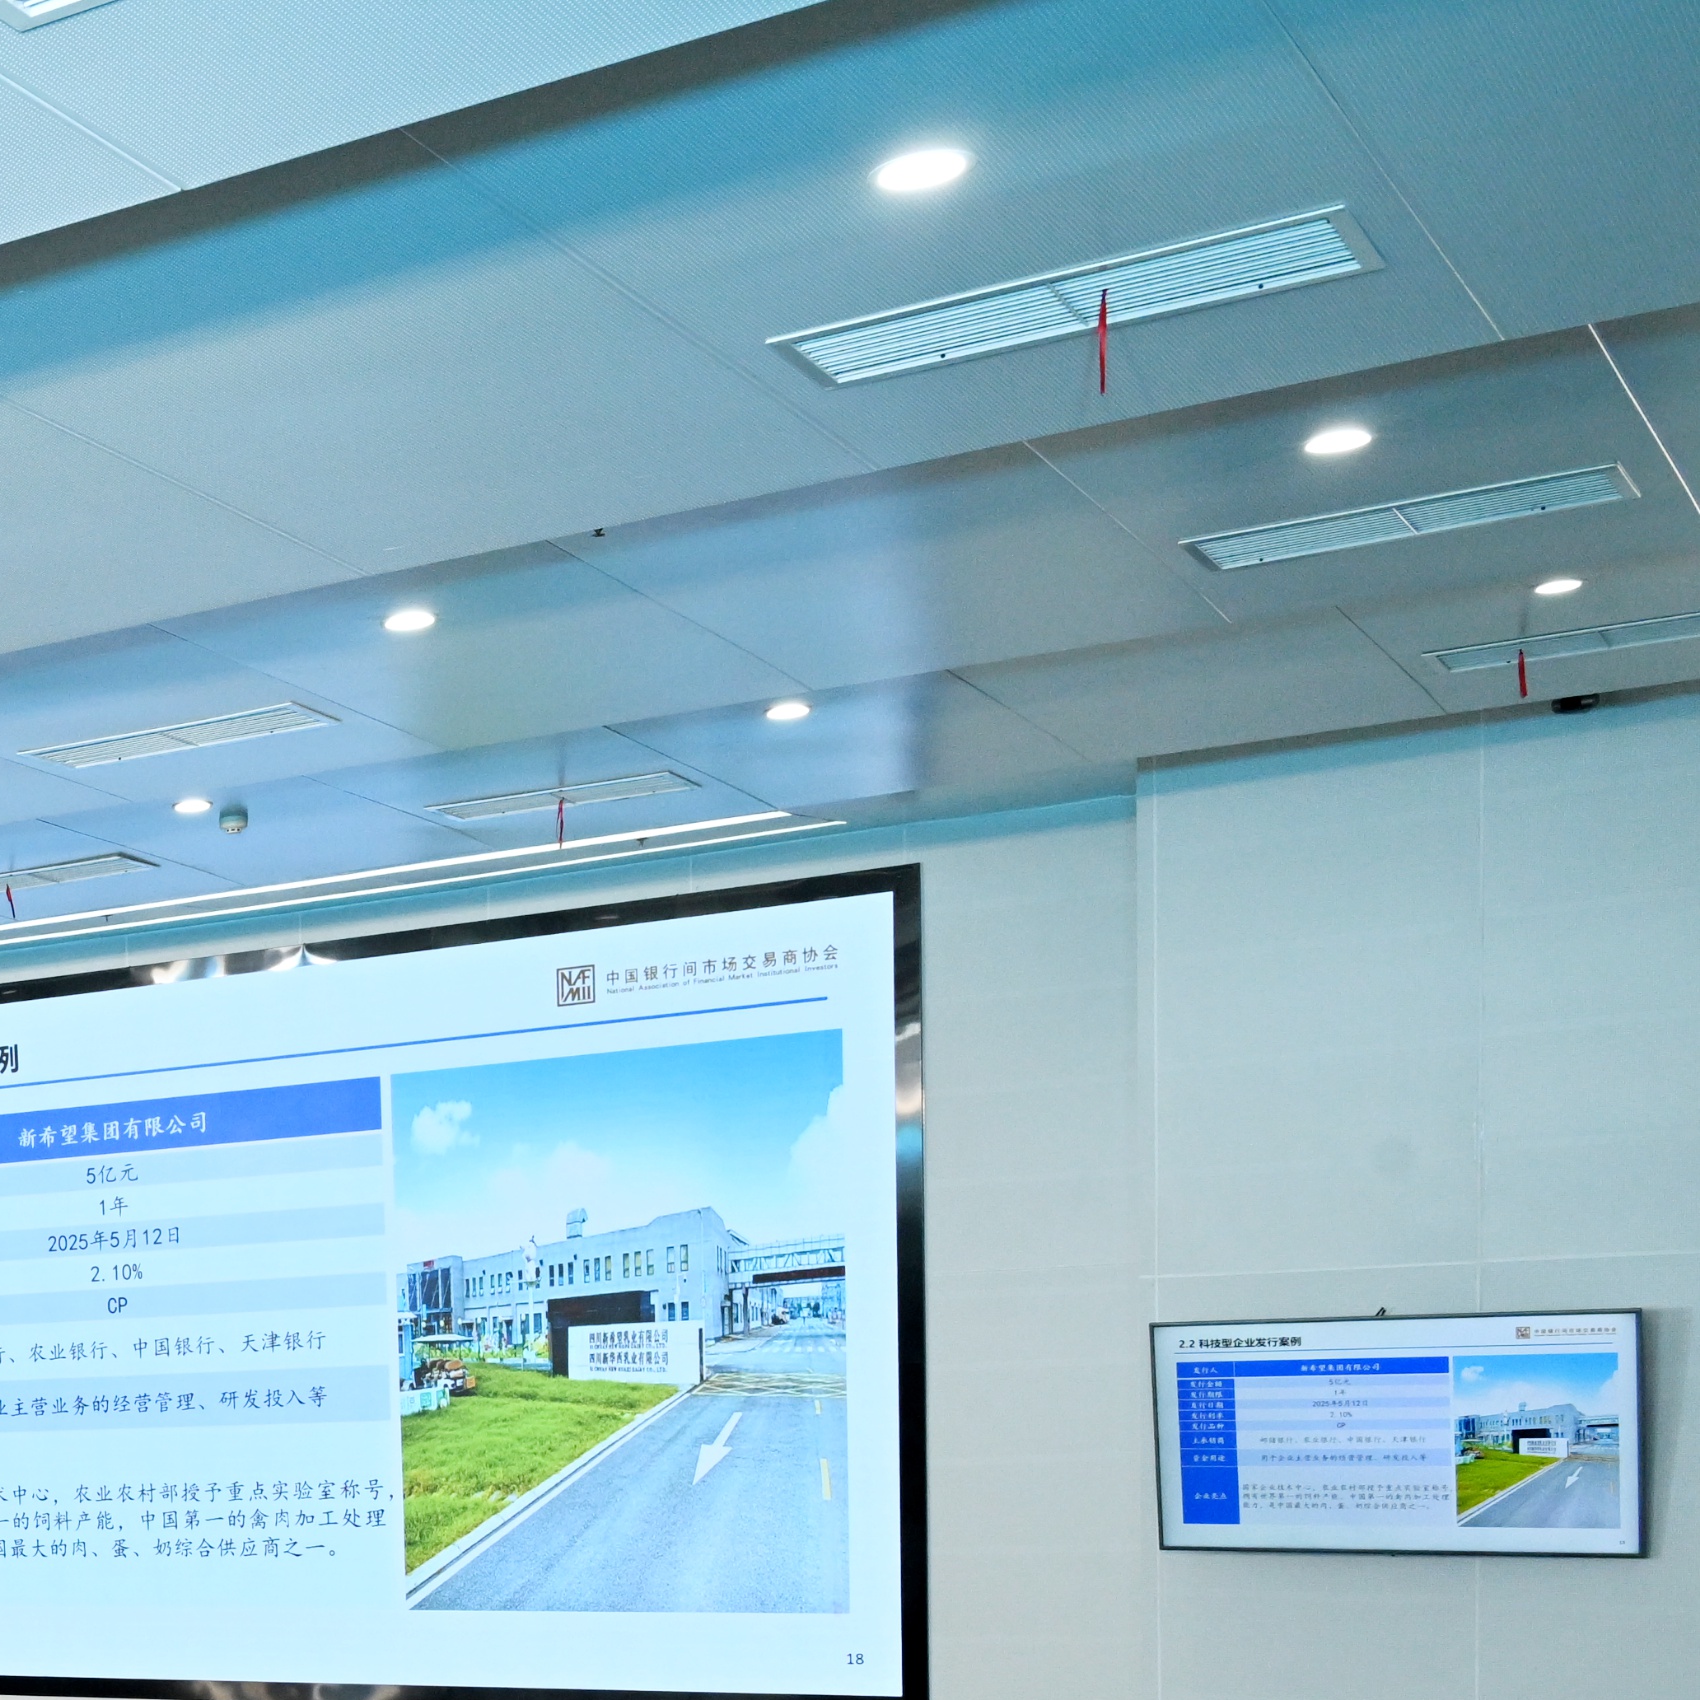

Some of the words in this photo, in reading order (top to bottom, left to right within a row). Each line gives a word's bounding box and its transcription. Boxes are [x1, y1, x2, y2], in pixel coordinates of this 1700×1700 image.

[606, 944, 839, 986] 中国银行间市场交易商协会
[606, 986, 635, 995] National
[638, 981, 680, 991] Association
[682, 978, 691, 986] of
[693, 976, 725, 985] Financial
[728, 973, 753, 981] Market
[757, 967, 801, 977] Institutional
[804, 963, 839, 972] Investors
[18, 1111, 207, 1149] 新希望集团有限公司
[86, 1163, 139, 1185] 5亿元
[98, 1195, 129, 1217] 1年
[48, 1226, 180, 1252] 2025年5月12日
[90, 1262, 144, 1283] 2.10%
[107, 1297, 128, 1314] CP
[1179, 1340, 1195, 1348] 2.2
[1199, 1336, 1302, 1348] 科技型企业发行案例
[846, 1652, 865, 1665] 18
